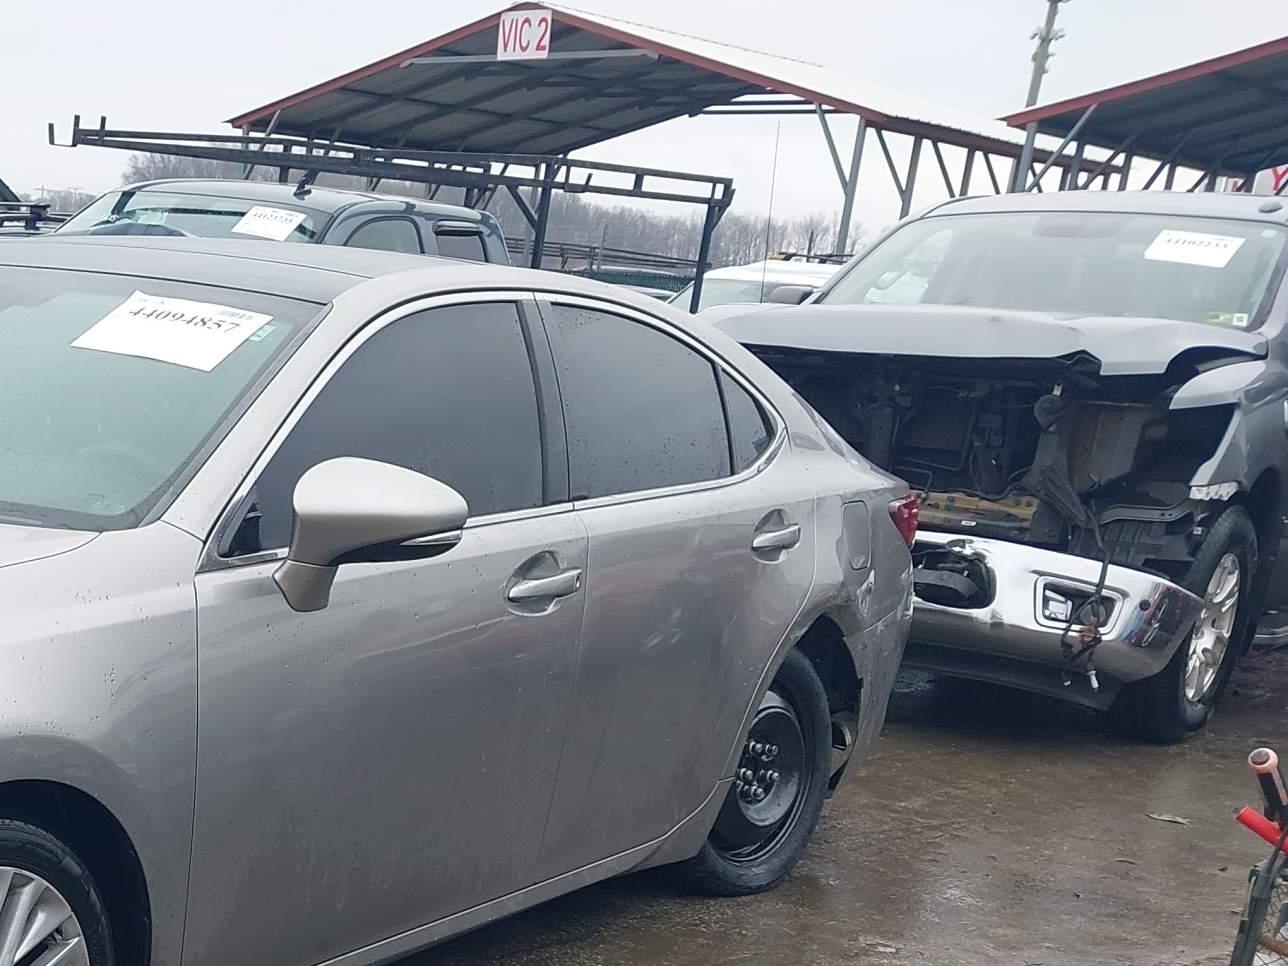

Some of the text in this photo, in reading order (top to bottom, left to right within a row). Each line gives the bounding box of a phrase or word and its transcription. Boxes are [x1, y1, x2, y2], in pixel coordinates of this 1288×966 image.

[502, 16, 549, 53] VIC 2
[129, 307, 241, 333] 44094857
